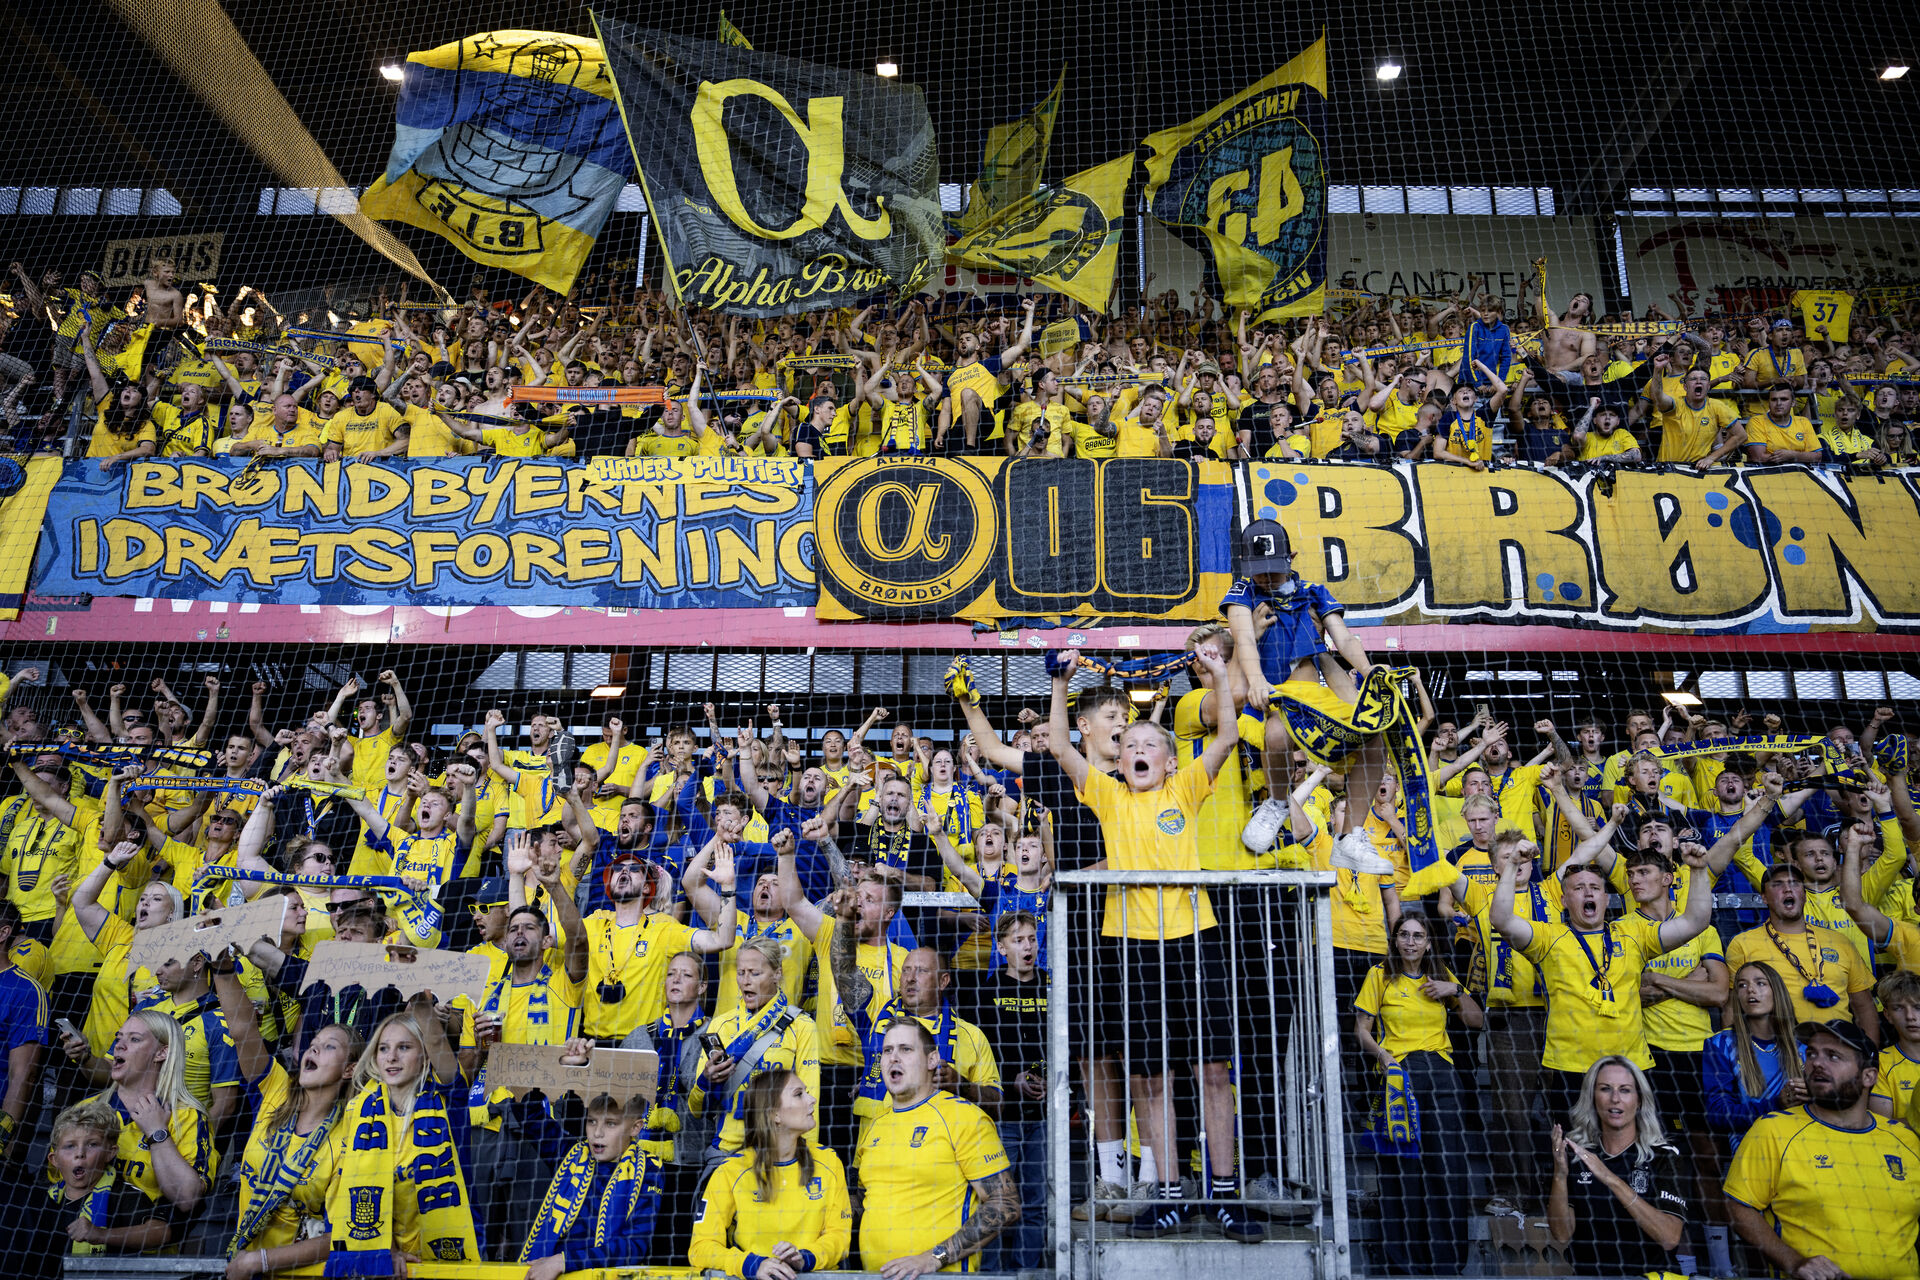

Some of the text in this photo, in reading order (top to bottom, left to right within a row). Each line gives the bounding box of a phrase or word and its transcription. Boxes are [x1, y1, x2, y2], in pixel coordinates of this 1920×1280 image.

[1812, 303, 1839, 323] 37
[593, 457, 682, 481] HADER
[859, 578, 954, 600] BRØNDBY
[263, 871, 344, 885] BRØNDBY
[348, 875, 373, 886] I.F.
[352, 1228, 378, 1239] 1964
